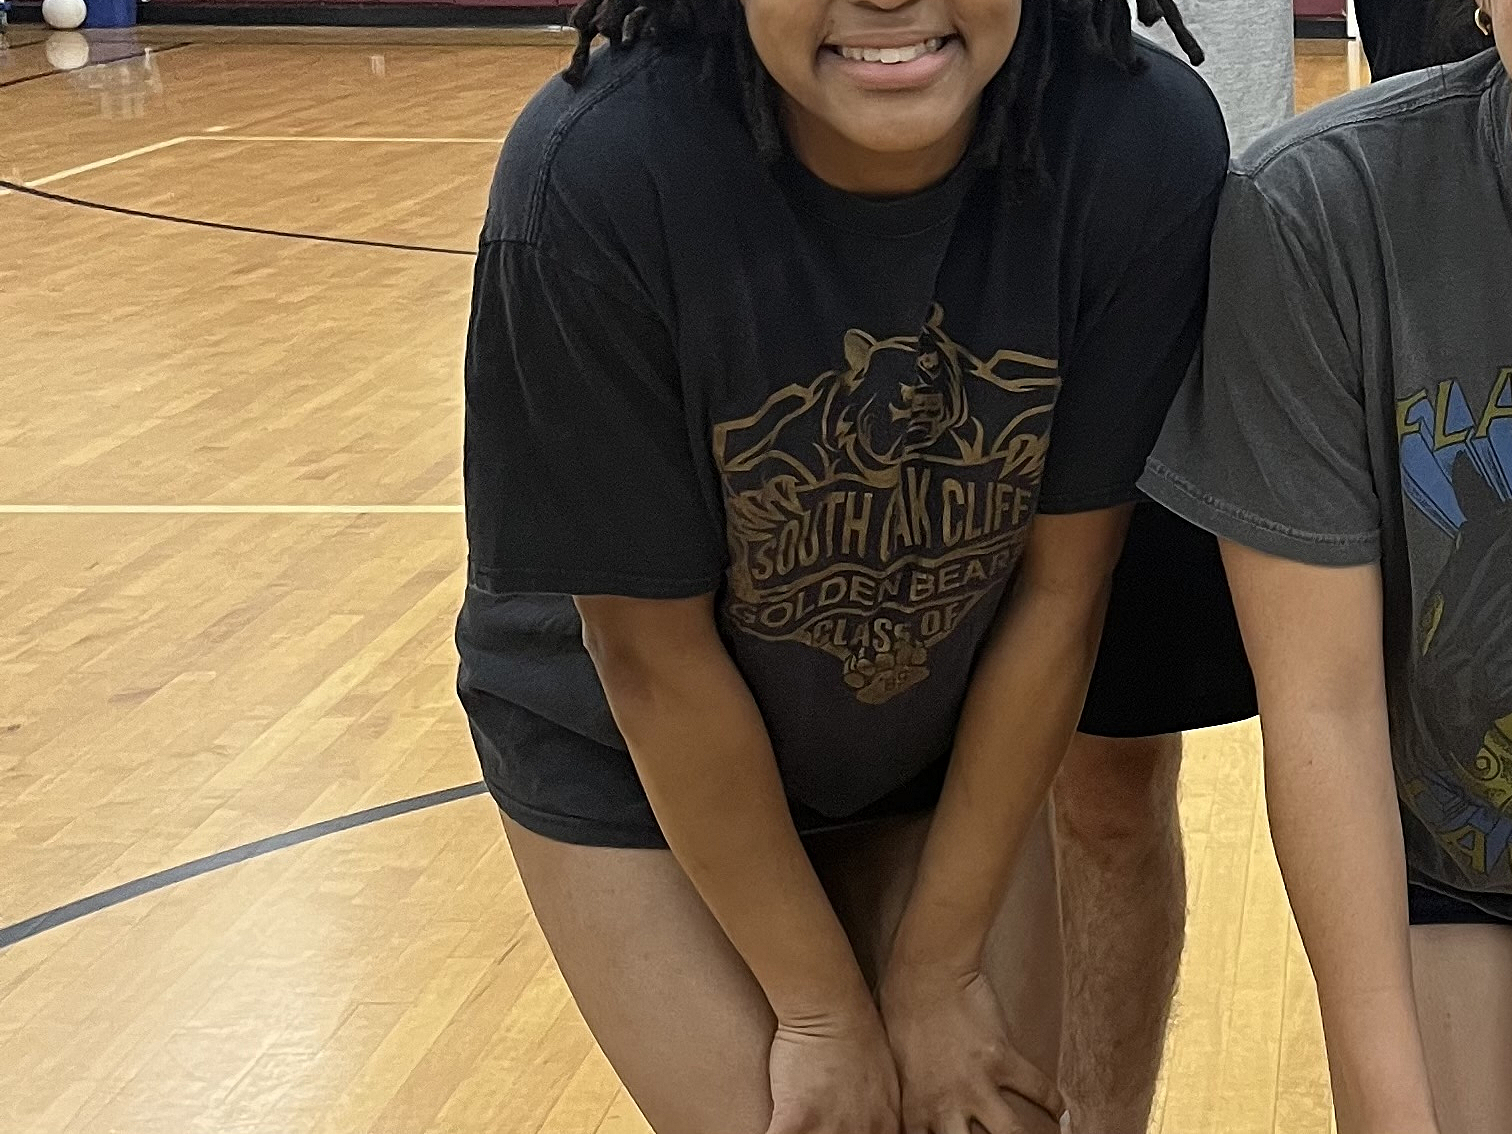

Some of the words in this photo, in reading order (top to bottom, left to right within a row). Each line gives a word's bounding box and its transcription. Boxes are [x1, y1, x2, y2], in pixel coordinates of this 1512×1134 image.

[752, 491, 874, 581] SOUTH
[942, 478, 1032, 548] CLIFF
[730, 573, 900, 629] GOLDEN
[920, 603, 960, 636] OF
